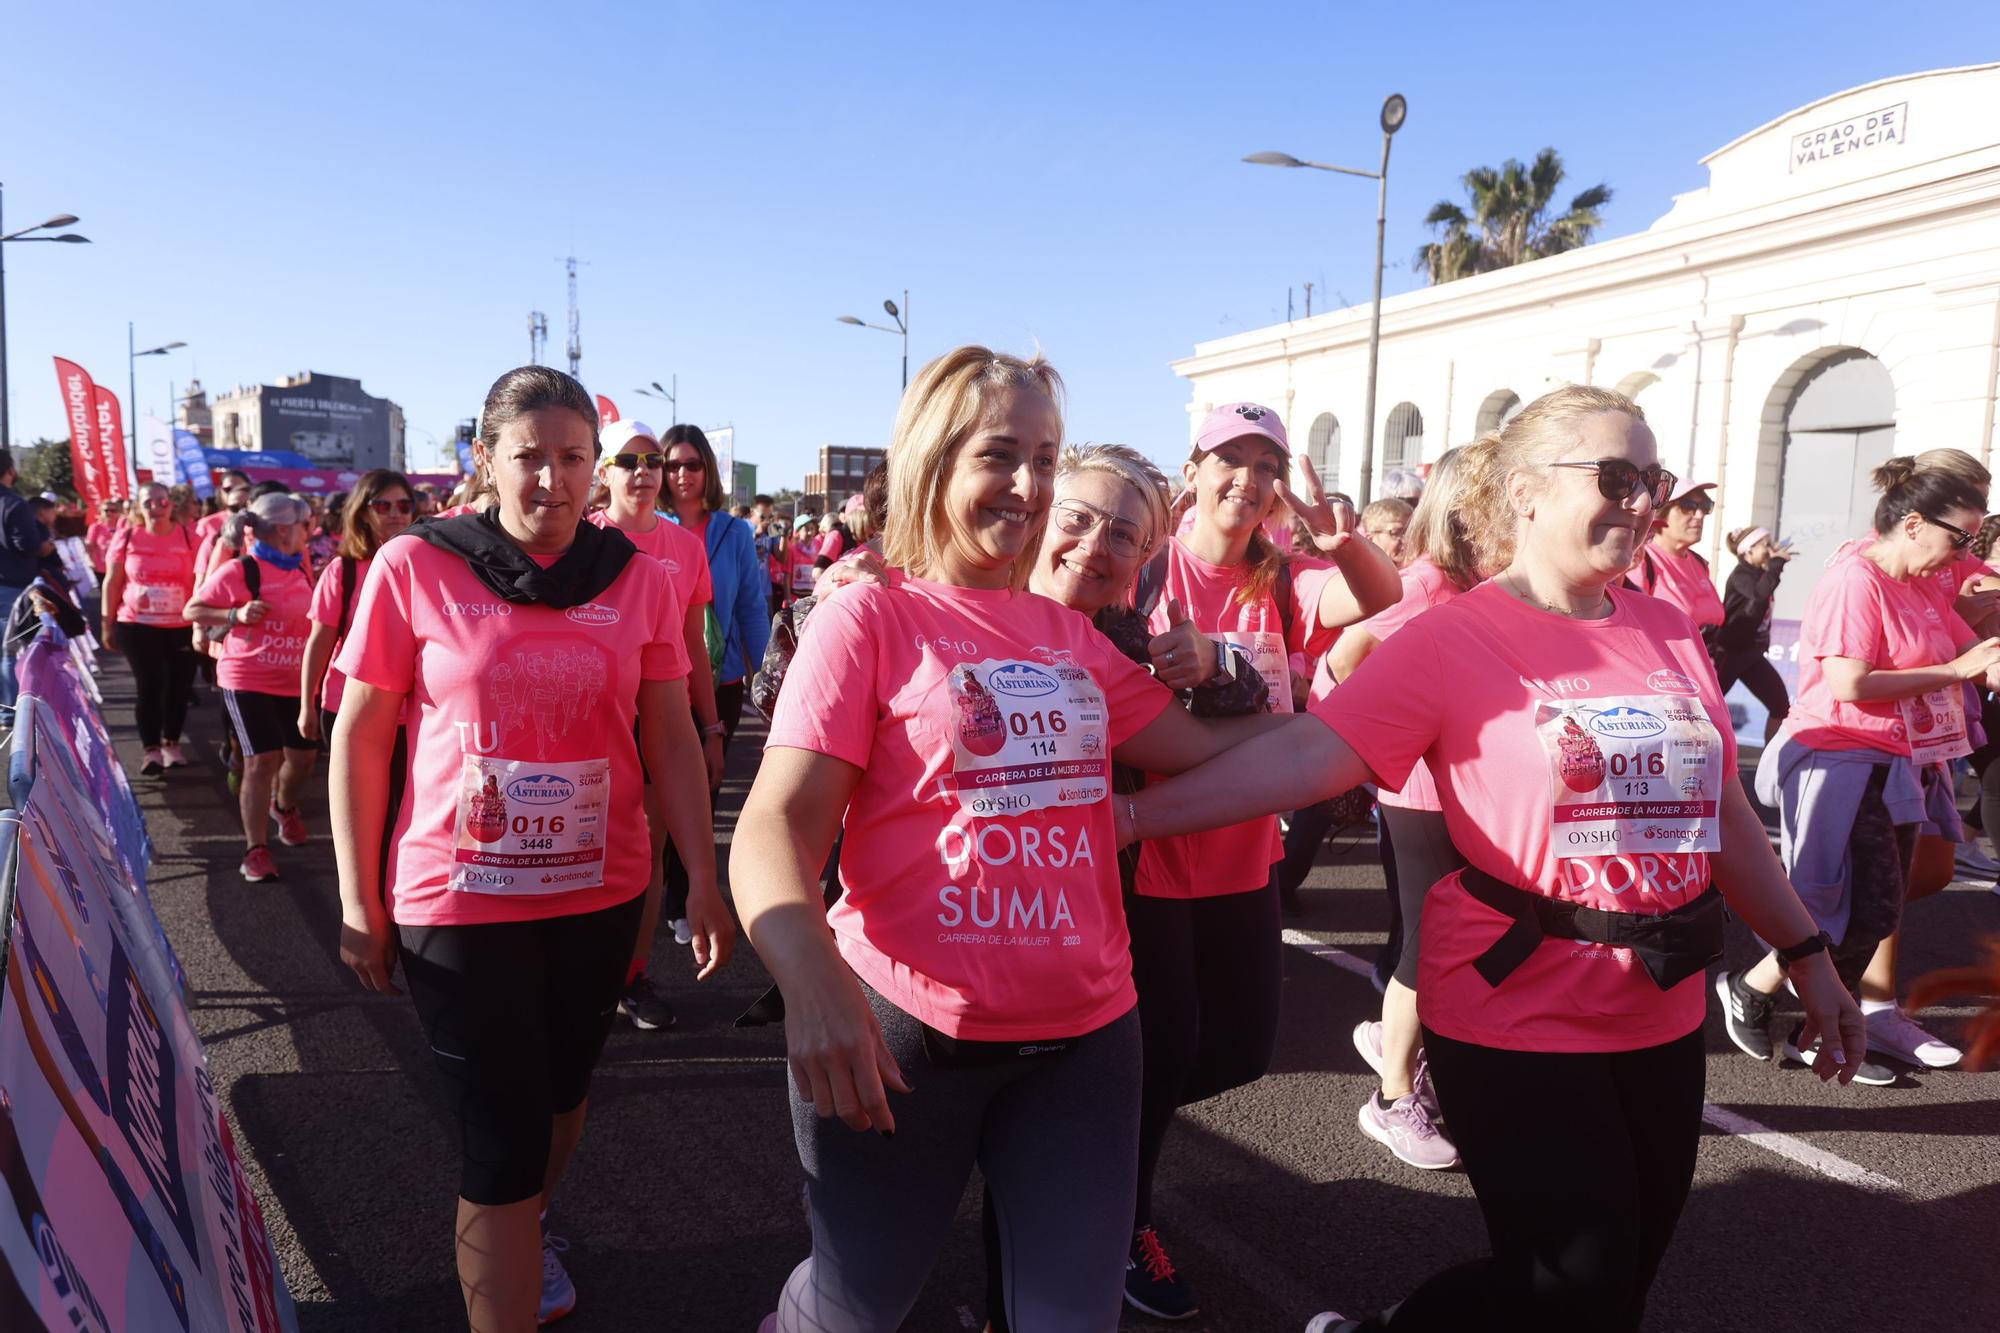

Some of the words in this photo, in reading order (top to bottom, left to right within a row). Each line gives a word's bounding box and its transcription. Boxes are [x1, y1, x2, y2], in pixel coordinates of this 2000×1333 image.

[1801, 125, 1854, 148] GRAO
[1866, 111, 1894, 130] DE
[1797, 128, 1896, 165] VALENCIA
[442, 603, 512, 616] OYSHO
[571, 611, 617, 621] ASTURIANA
[264, 621, 284, 632] TU
[257, 652, 302, 666] SUMA
[996, 676, 1056, 689] ASTURIANA
[1059, 672, 1088, 681] SUMA
[1009, 710, 1067, 736] 016
[1597, 720, 1663, 731] ASTURIANA
[454, 721, 498, 753] TU
[1031, 740, 1057, 757] 114
[1611, 752, 1665, 776] 016
[975, 770, 1026, 784] CARRERA
[1029, 769, 1043, 778] DE
[1045, 767, 1056, 776] LA
[1057, 765, 1080, 774] MUJER
[1082, 764, 1100, 773] 2023
[579, 777, 602, 787] SUMA
[1625, 781, 1649, 796] 113
[512, 784, 570, 797] ASTURIANA
[1066, 788, 1104, 800] Santander
[972, 794, 1031, 812] OYSHO
[1617, 807, 1630, 815] DE
[1633, 806, 1644, 815] LA
[1647, 805, 1681, 814] MUJER
[1683, 805, 1704, 814] 2023
[512, 815, 565, 834] 016
[1568, 829, 1622, 844] OYSHO
[1657, 828, 1708, 840] Santander
[520, 838, 553, 850] 3448
[472, 854, 516, 865] CARRERA
[546, 856, 575, 864] MUJER
[466, 871, 514, 885] OYSHO
[553, 870, 594, 883] Santander
[937, 886, 1076, 930] SUMA
[938, 933, 986, 944] CARRERA
[988, 934, 1002, 945] DE
[1004, 935, 1017, 945] LA
[1018, 936, 1050, 946] MUJER
[1062, 935, 1081, 946] 2023
